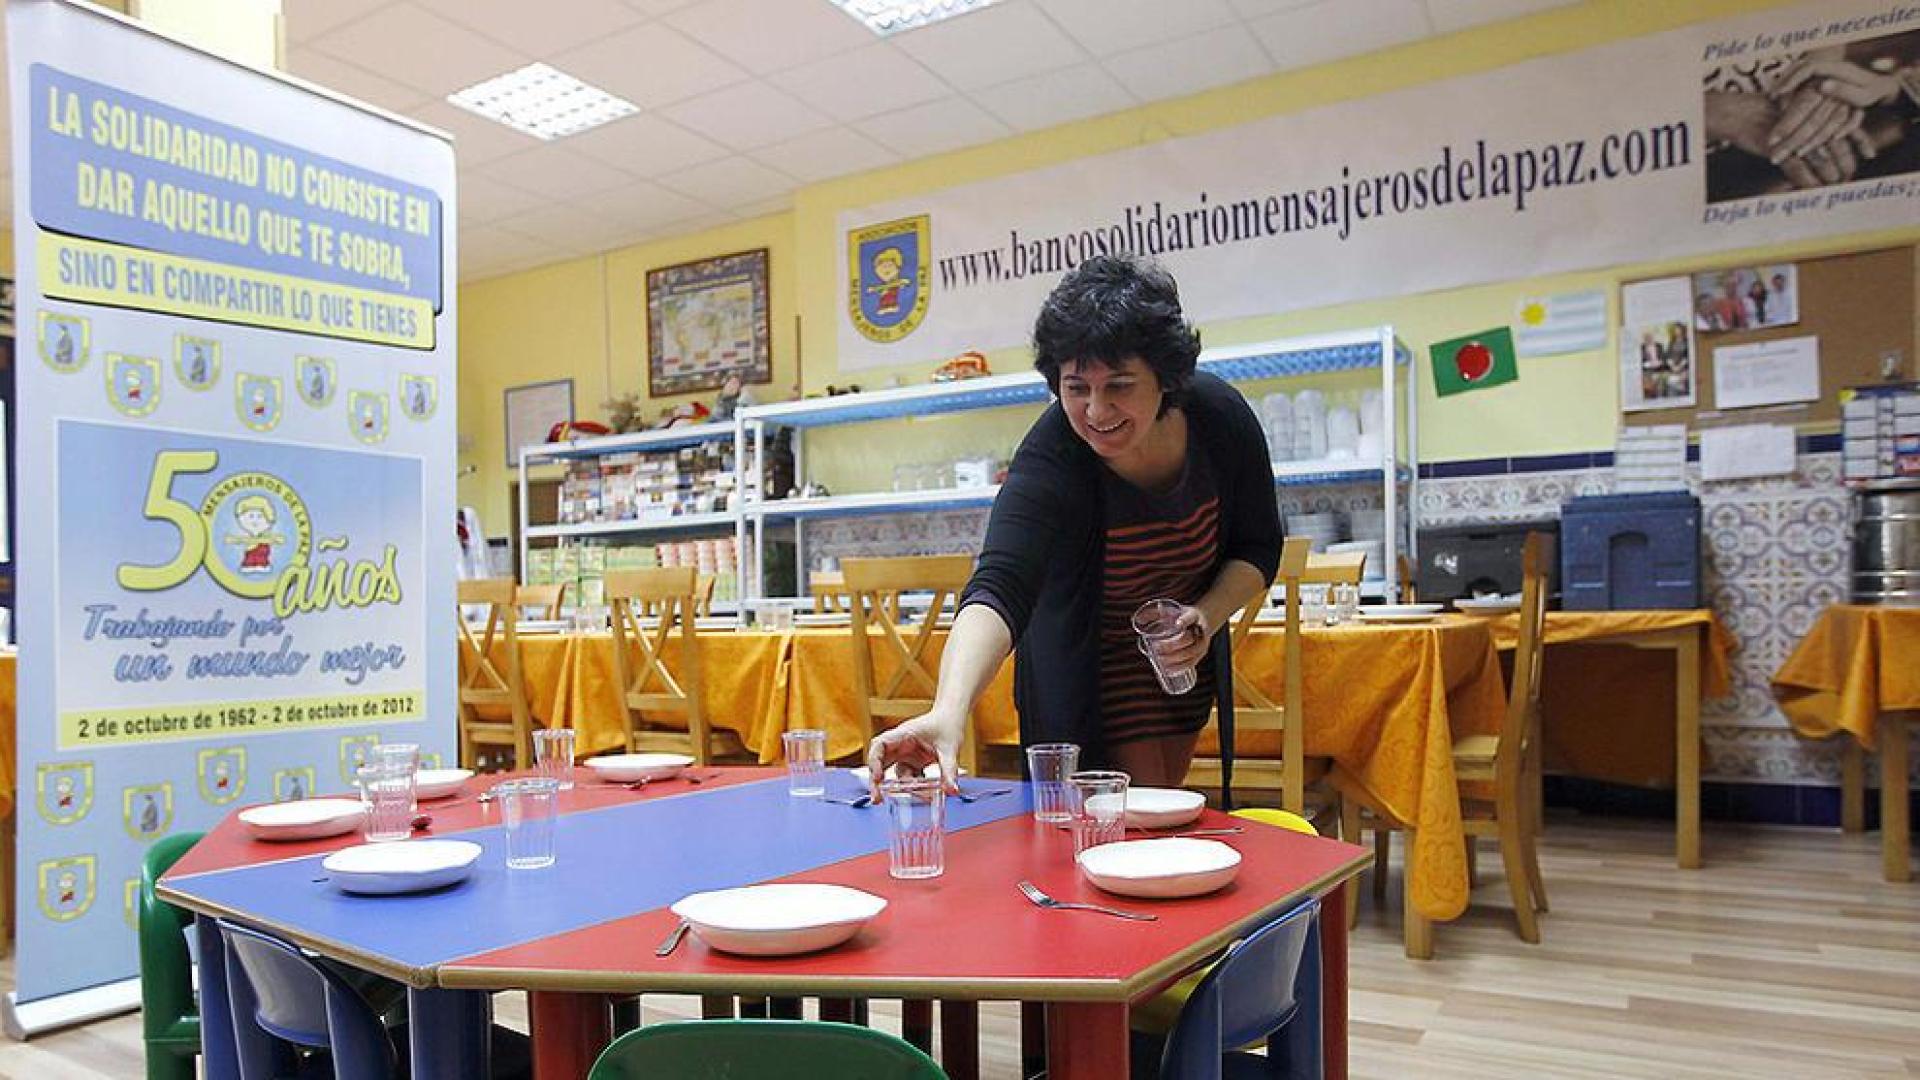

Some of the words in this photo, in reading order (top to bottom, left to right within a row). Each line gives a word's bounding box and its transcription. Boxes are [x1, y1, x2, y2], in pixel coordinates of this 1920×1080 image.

[1704, 39, 1748, 60] Pide
[1754, 33, 1774, 50] lo
[1780, 27, 1822, 48] que
[1825, 6, 1920, 34] necesite
[50, 86, 83, 138] LA
[92, 99, 259, 188] SOLIDARIDAD
[266, 152, 297, 199] NO
[303, 165, 400, 230] CONSISTE
[405, 195, 430, 236] EN
[78, 161, 134, 217] DAR
[144, 179, 251, 246] AQUELLO
[258, 209, 303, 257] QUE
[308, 222, 334, 266] TE
[339, 231, 411, 291] SOBRA,
[938, 117, 1691, 290] www.bancosolidariomensajerosdelapaz.com
[1704, 205, 1750, 225] Deja
[1756, 199, 1775, 215] lo
[1781, 195, 1822, 216] que
[58, 247, 116, 290] SINO
[126, 258, 155, 296] EN
[163, 265, 285, 318] COMPARTIR
[291, 288, 313, 321] LO
[319, 293, 354, 328] QUE
[360, 301, 417, 338] TIENES
[203, 474, 283, 516] MENSAJEROS
[116, 449, 312, 599] 50
[272, 535, 403, 619] años
[83, 604, 236, 648] Trabajando
[240, 615, 285, 648] por
[114, 653, 174, 683] un
[186, 635, 310, 680] mundo
[320, 642, 407, 686] mejor
[79, 719, 89, 738] 2
[97, 717, 118, 737] de
[124, 713, 188, 735] octubre
[194, 710, 212, 729] de
[219, 707, 257, 727] 1962
[273, 706, 281, 723] 2
[287, 704, 304, 722] de
[308, 701, 358, 720] octubre
[363, 700, 379, 716] de
[383, 697, 414, 714] 2012
